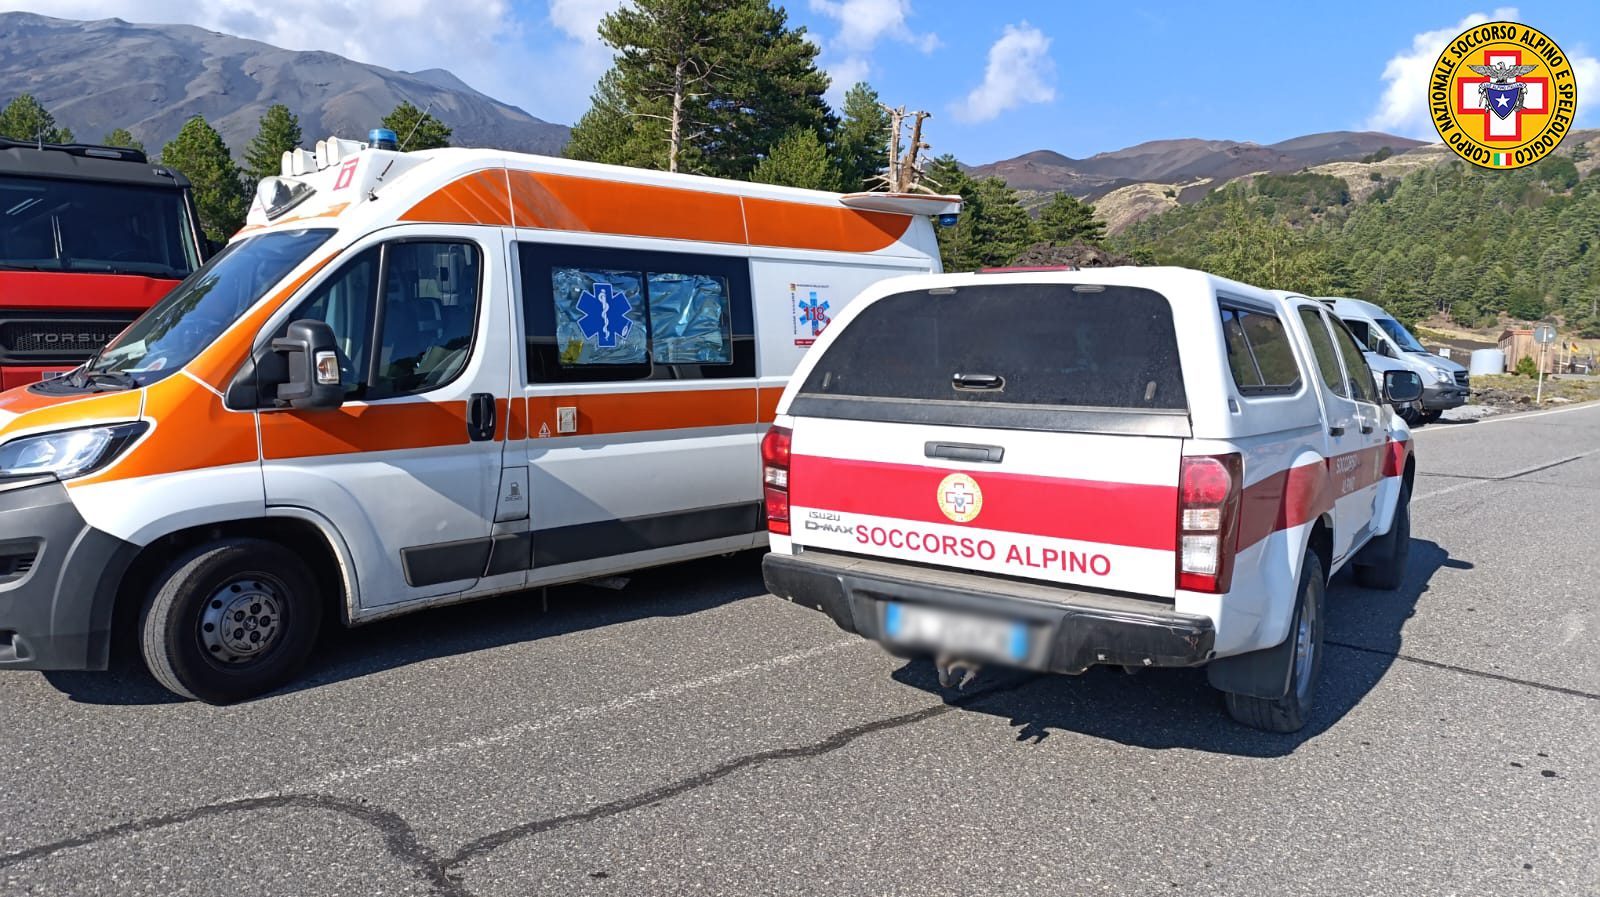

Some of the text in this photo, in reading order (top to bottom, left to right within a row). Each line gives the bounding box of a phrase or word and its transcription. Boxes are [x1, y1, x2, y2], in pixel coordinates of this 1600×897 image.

[803, 306, 825, 321] 118
[808, 510, 841, 522] ISUZU
[804, 520, 854, 535] D-MAX
[855, 524, 1112, 577] SOCCORSO ALPINO
